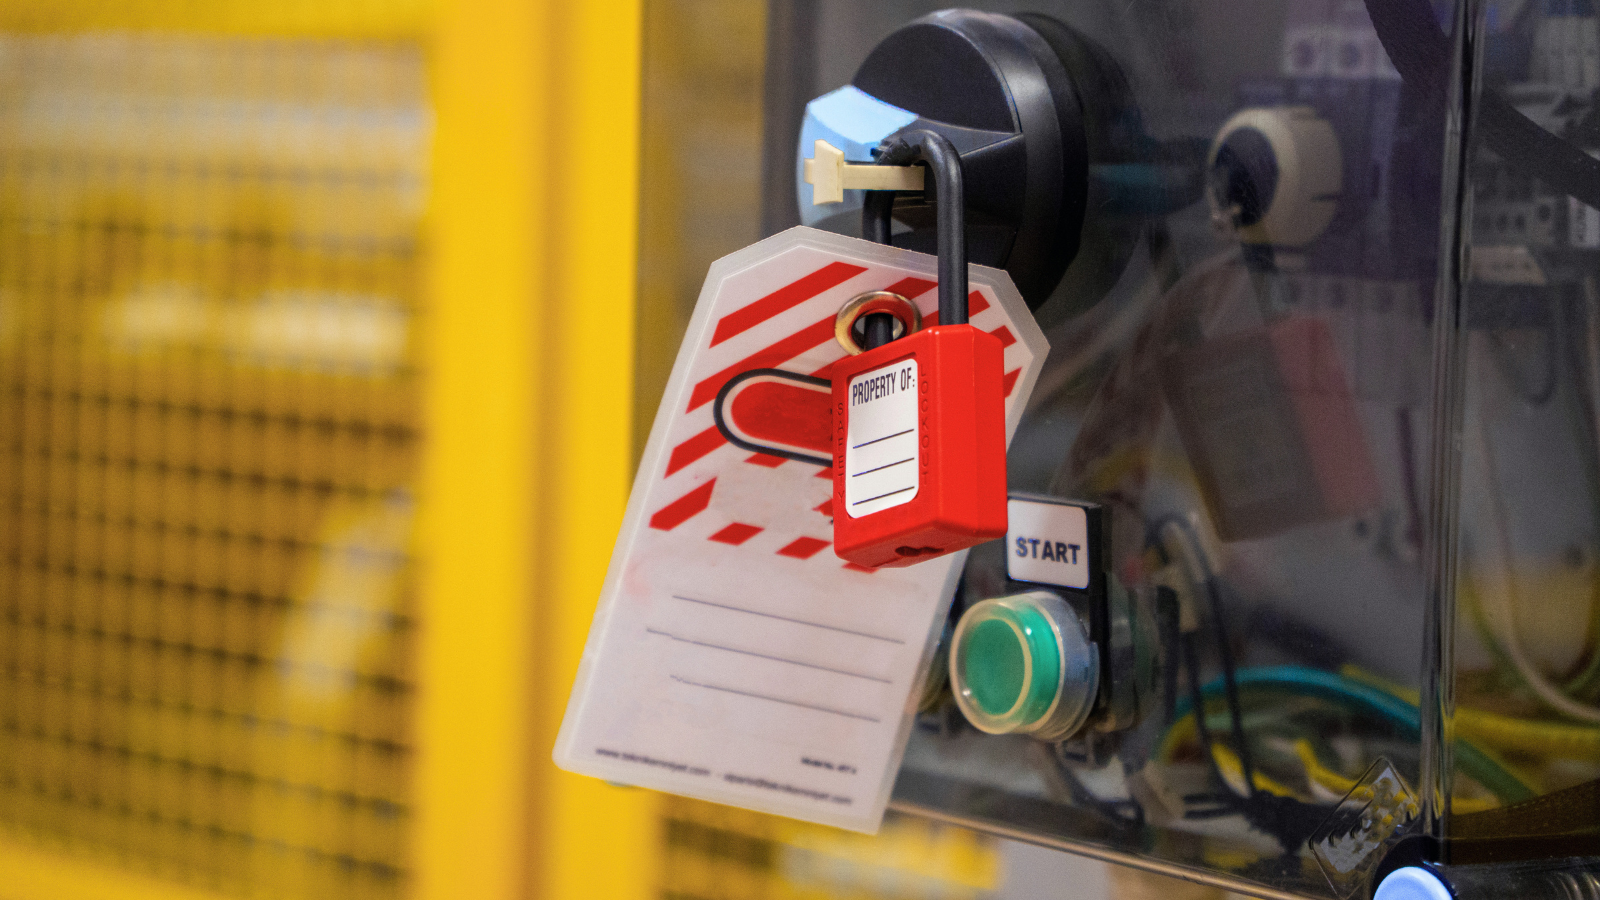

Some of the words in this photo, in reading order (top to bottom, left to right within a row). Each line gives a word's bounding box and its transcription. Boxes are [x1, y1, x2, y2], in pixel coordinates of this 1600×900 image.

[852, 371, 897, 406] PROPERTY
[900, 367, 916, 392] OF:
[837, 402, 845, 503] SAFETY
[920, 364, 930, 486] LOCKOUT
[1016, 536, 1081, 565] START
